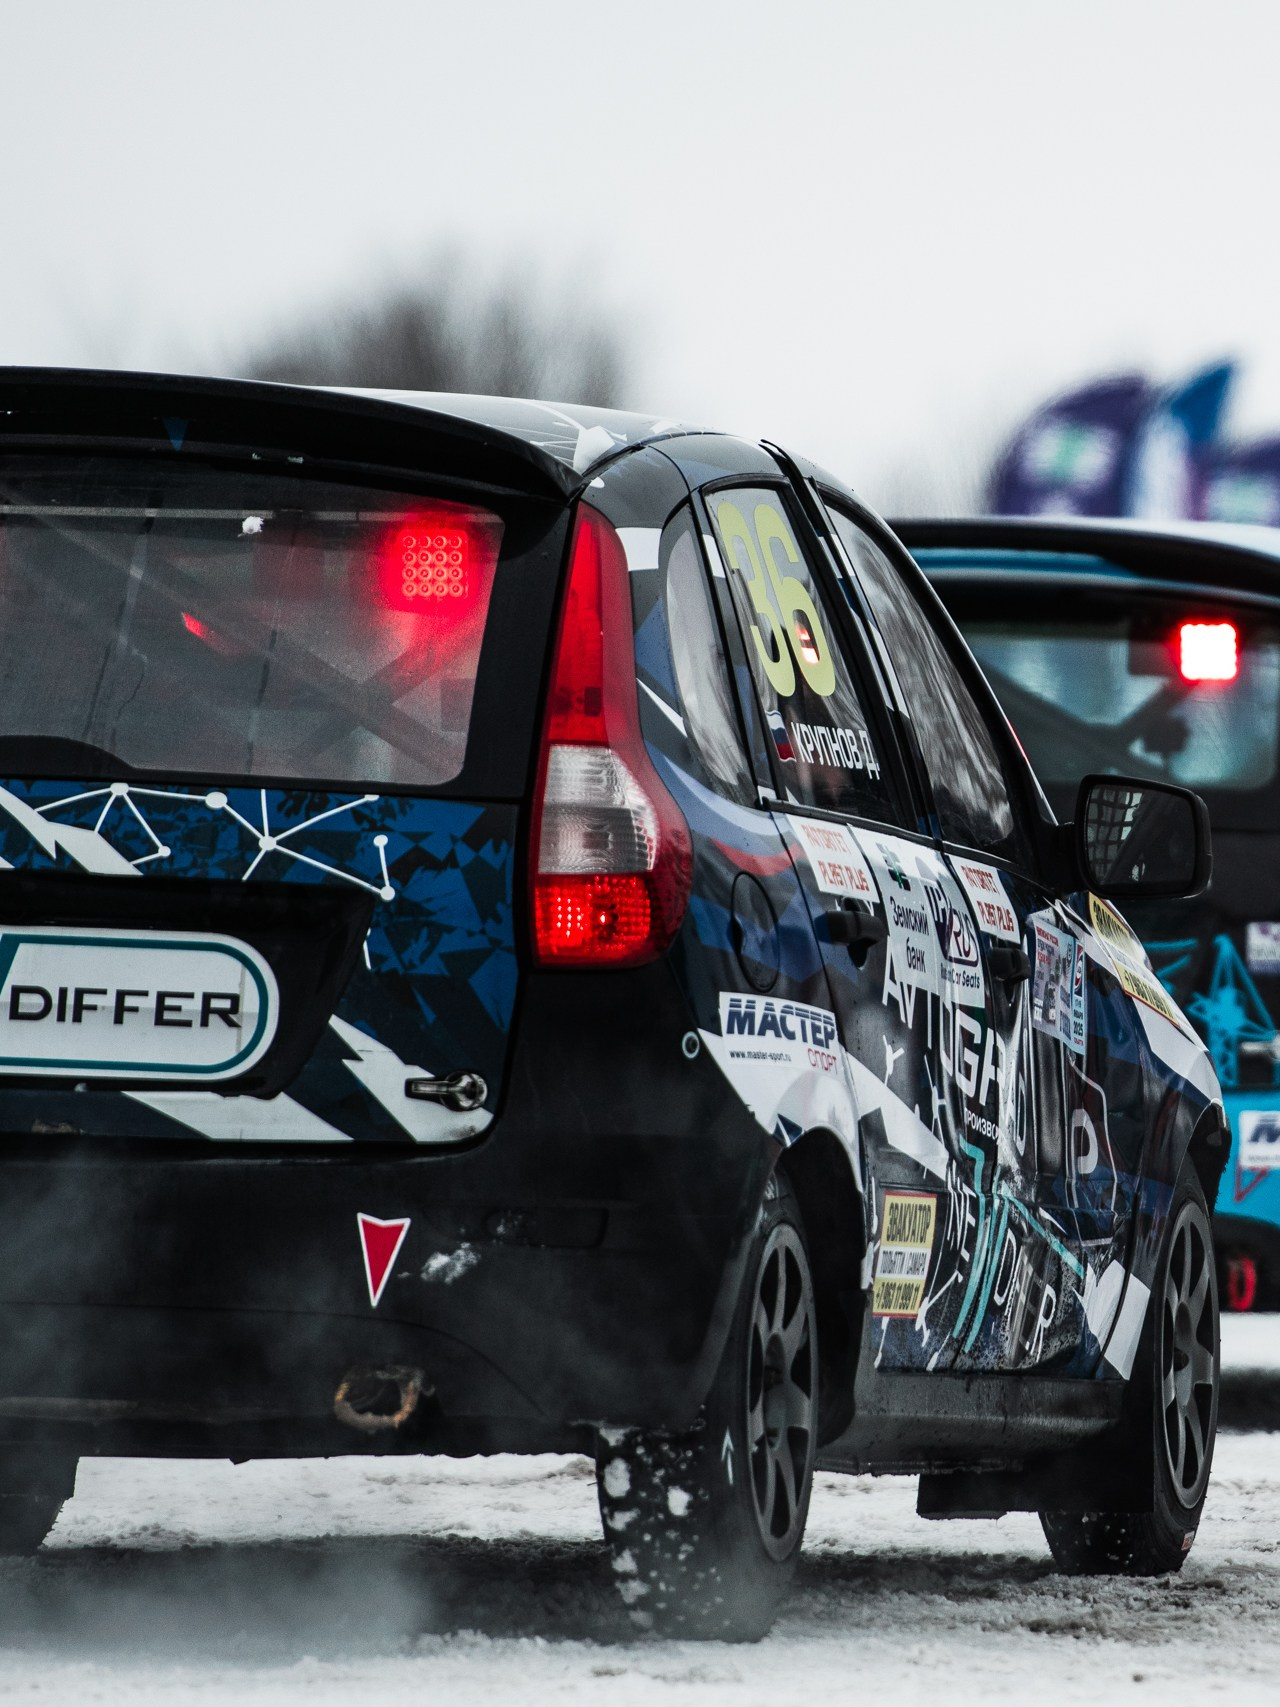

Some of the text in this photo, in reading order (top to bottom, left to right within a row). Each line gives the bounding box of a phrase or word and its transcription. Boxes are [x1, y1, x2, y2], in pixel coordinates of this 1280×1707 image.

[717, 502, 836, 697] 36
[791, 722, 863, 769] КРУПНОВ
[890, 896, 929, 936] Земский
[906, 937, 926, 973] банк
[962, 970, 981, 989] Seats
[8, 984, 242, 1028] DIFFER
[727, 998, 836, 1050] МАСТЕР
[807, 1048, 838, 1075] СПОРТ
[886, 1202, 931, 1243] ЭВАКУАТОР
